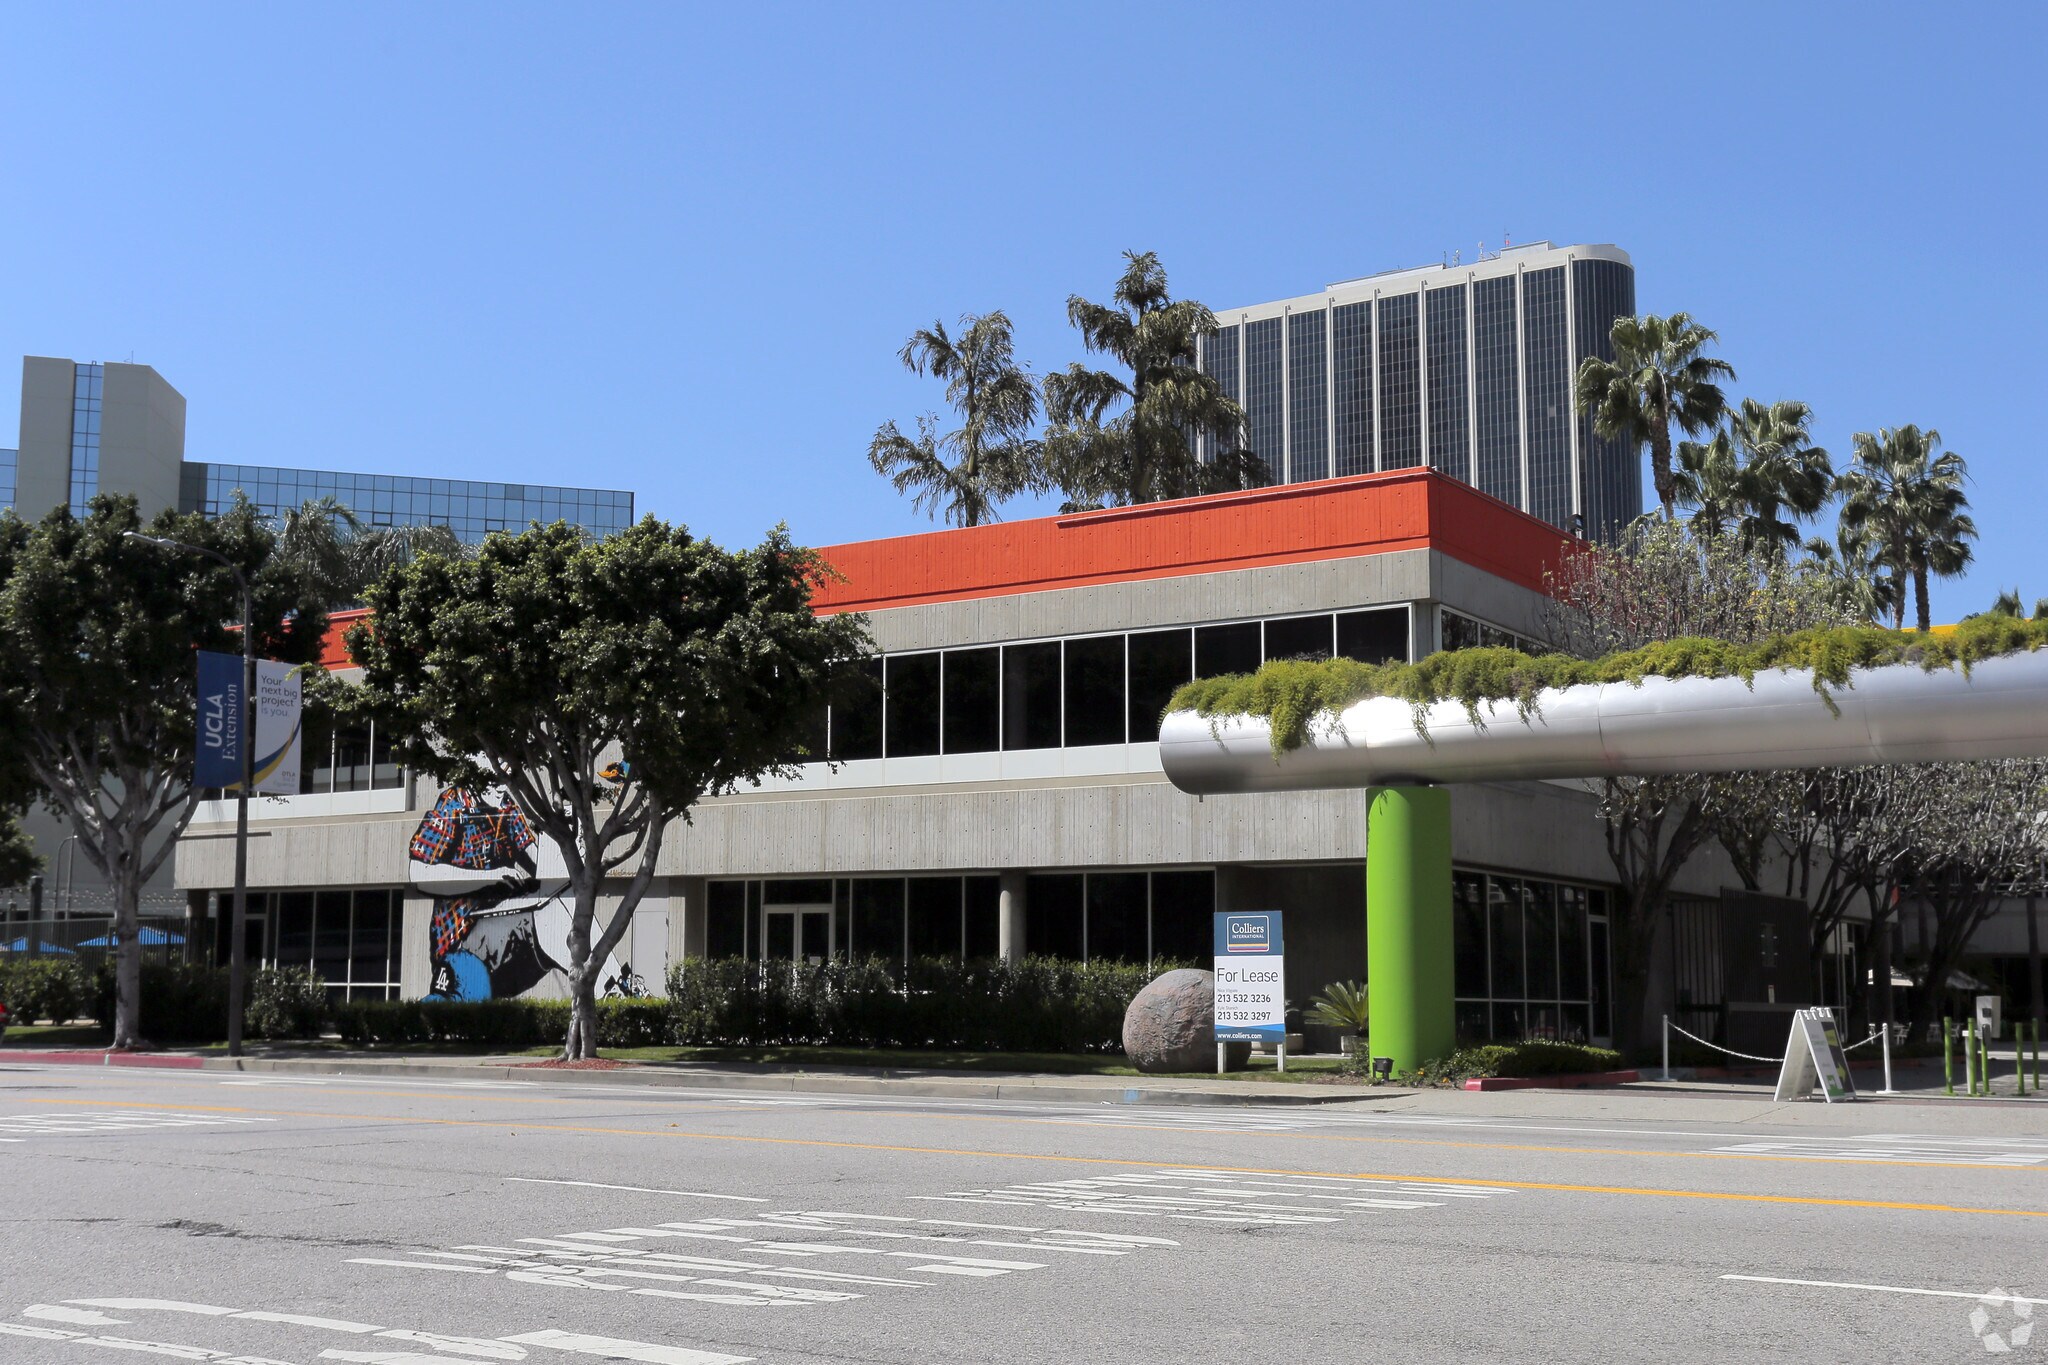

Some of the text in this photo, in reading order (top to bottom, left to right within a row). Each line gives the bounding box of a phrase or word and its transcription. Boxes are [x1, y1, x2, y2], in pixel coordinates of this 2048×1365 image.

[261, 674, 283, 686] Your
[261, 686, 298, 700] next big
[261, 696, 295, 707] project
[261, 707, 268, 715] is
[205, 694, 223, 748] UCLA
[222, 684, 237, 760] Extension
[1231, 922, 1264, 934] Colliers
[1217, 967, 1279, 983] For Lease
[1217, 993, 1271, 1003] 213 532 3236
[1217, 1011, 1271, 1021] 213 532 3297
[1216, 1031, 1263, 1039] www.colliers.com
